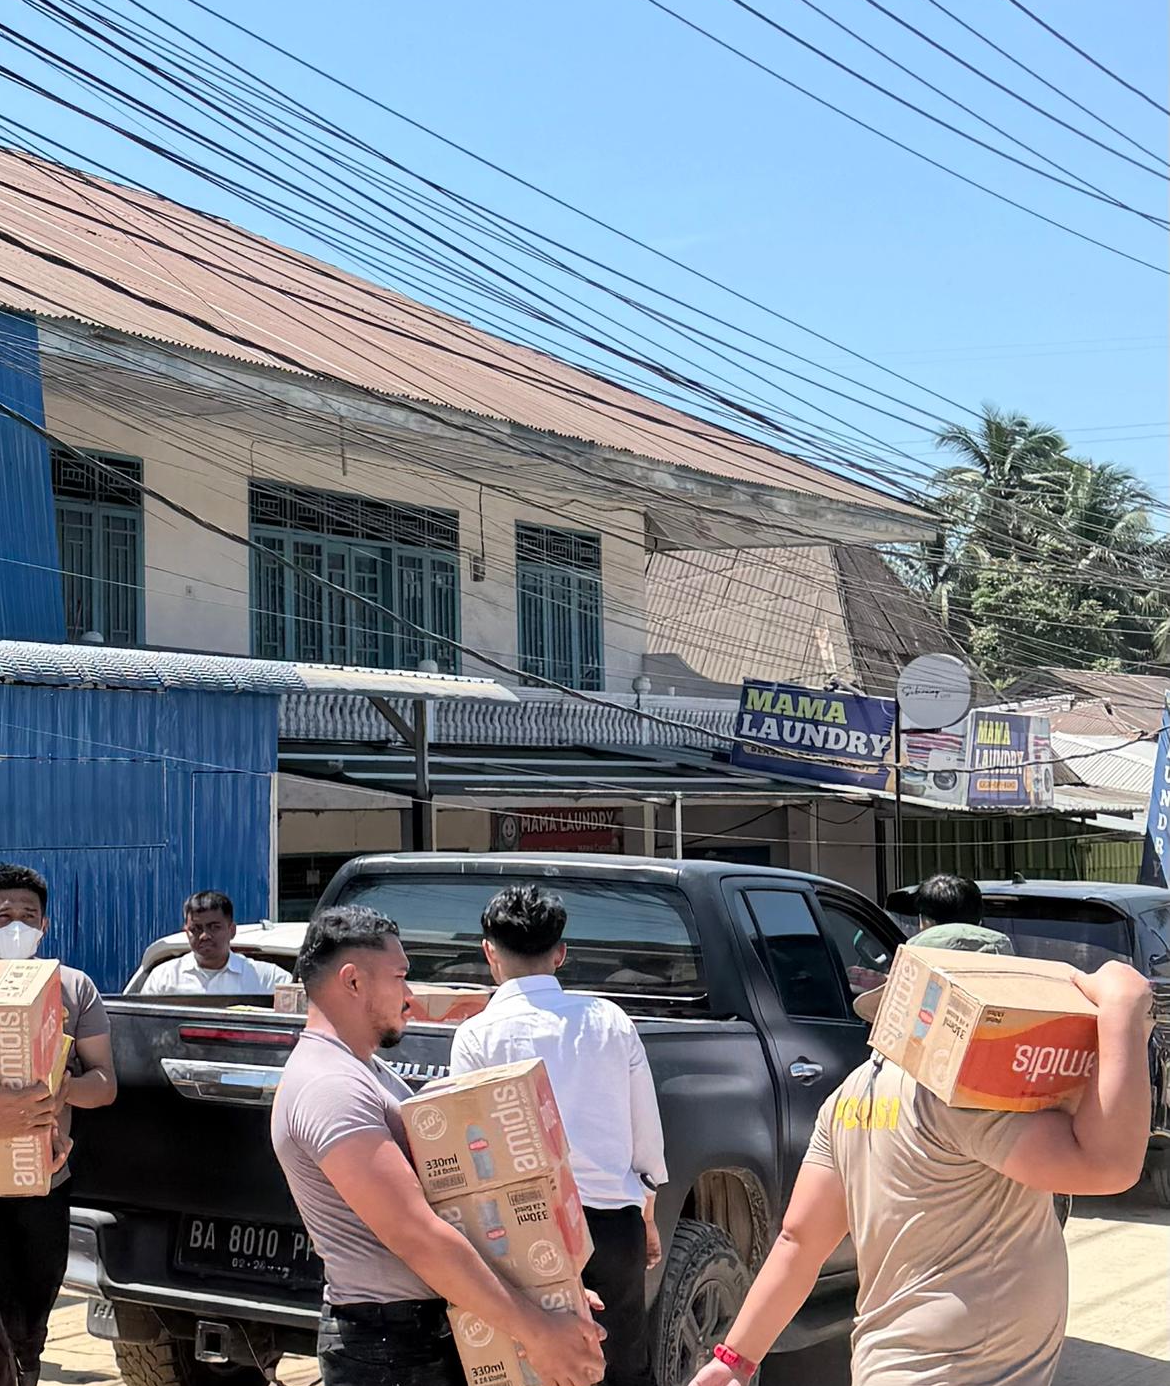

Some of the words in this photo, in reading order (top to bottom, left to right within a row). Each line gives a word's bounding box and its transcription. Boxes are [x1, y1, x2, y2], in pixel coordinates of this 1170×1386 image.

[744, 687, 848, 726] MAMA
[739, 713, 893, 758] LAUNDRY
[976, 720, 1011, 745] MAMA
[520, 813, 558, 833] MAMA
[559, 810, 615, 832] LAUNDRY
[491, 1084, 540, 1174] amidis
[426, 1153, 459, 1171] 330ml
[516, 1210, 549, 1226] 330ml
[189, 1220, 215, 1250] BA
[229, 1225, 278, 1258] 8010
[470, 1361, 505, 1379] 330ml
